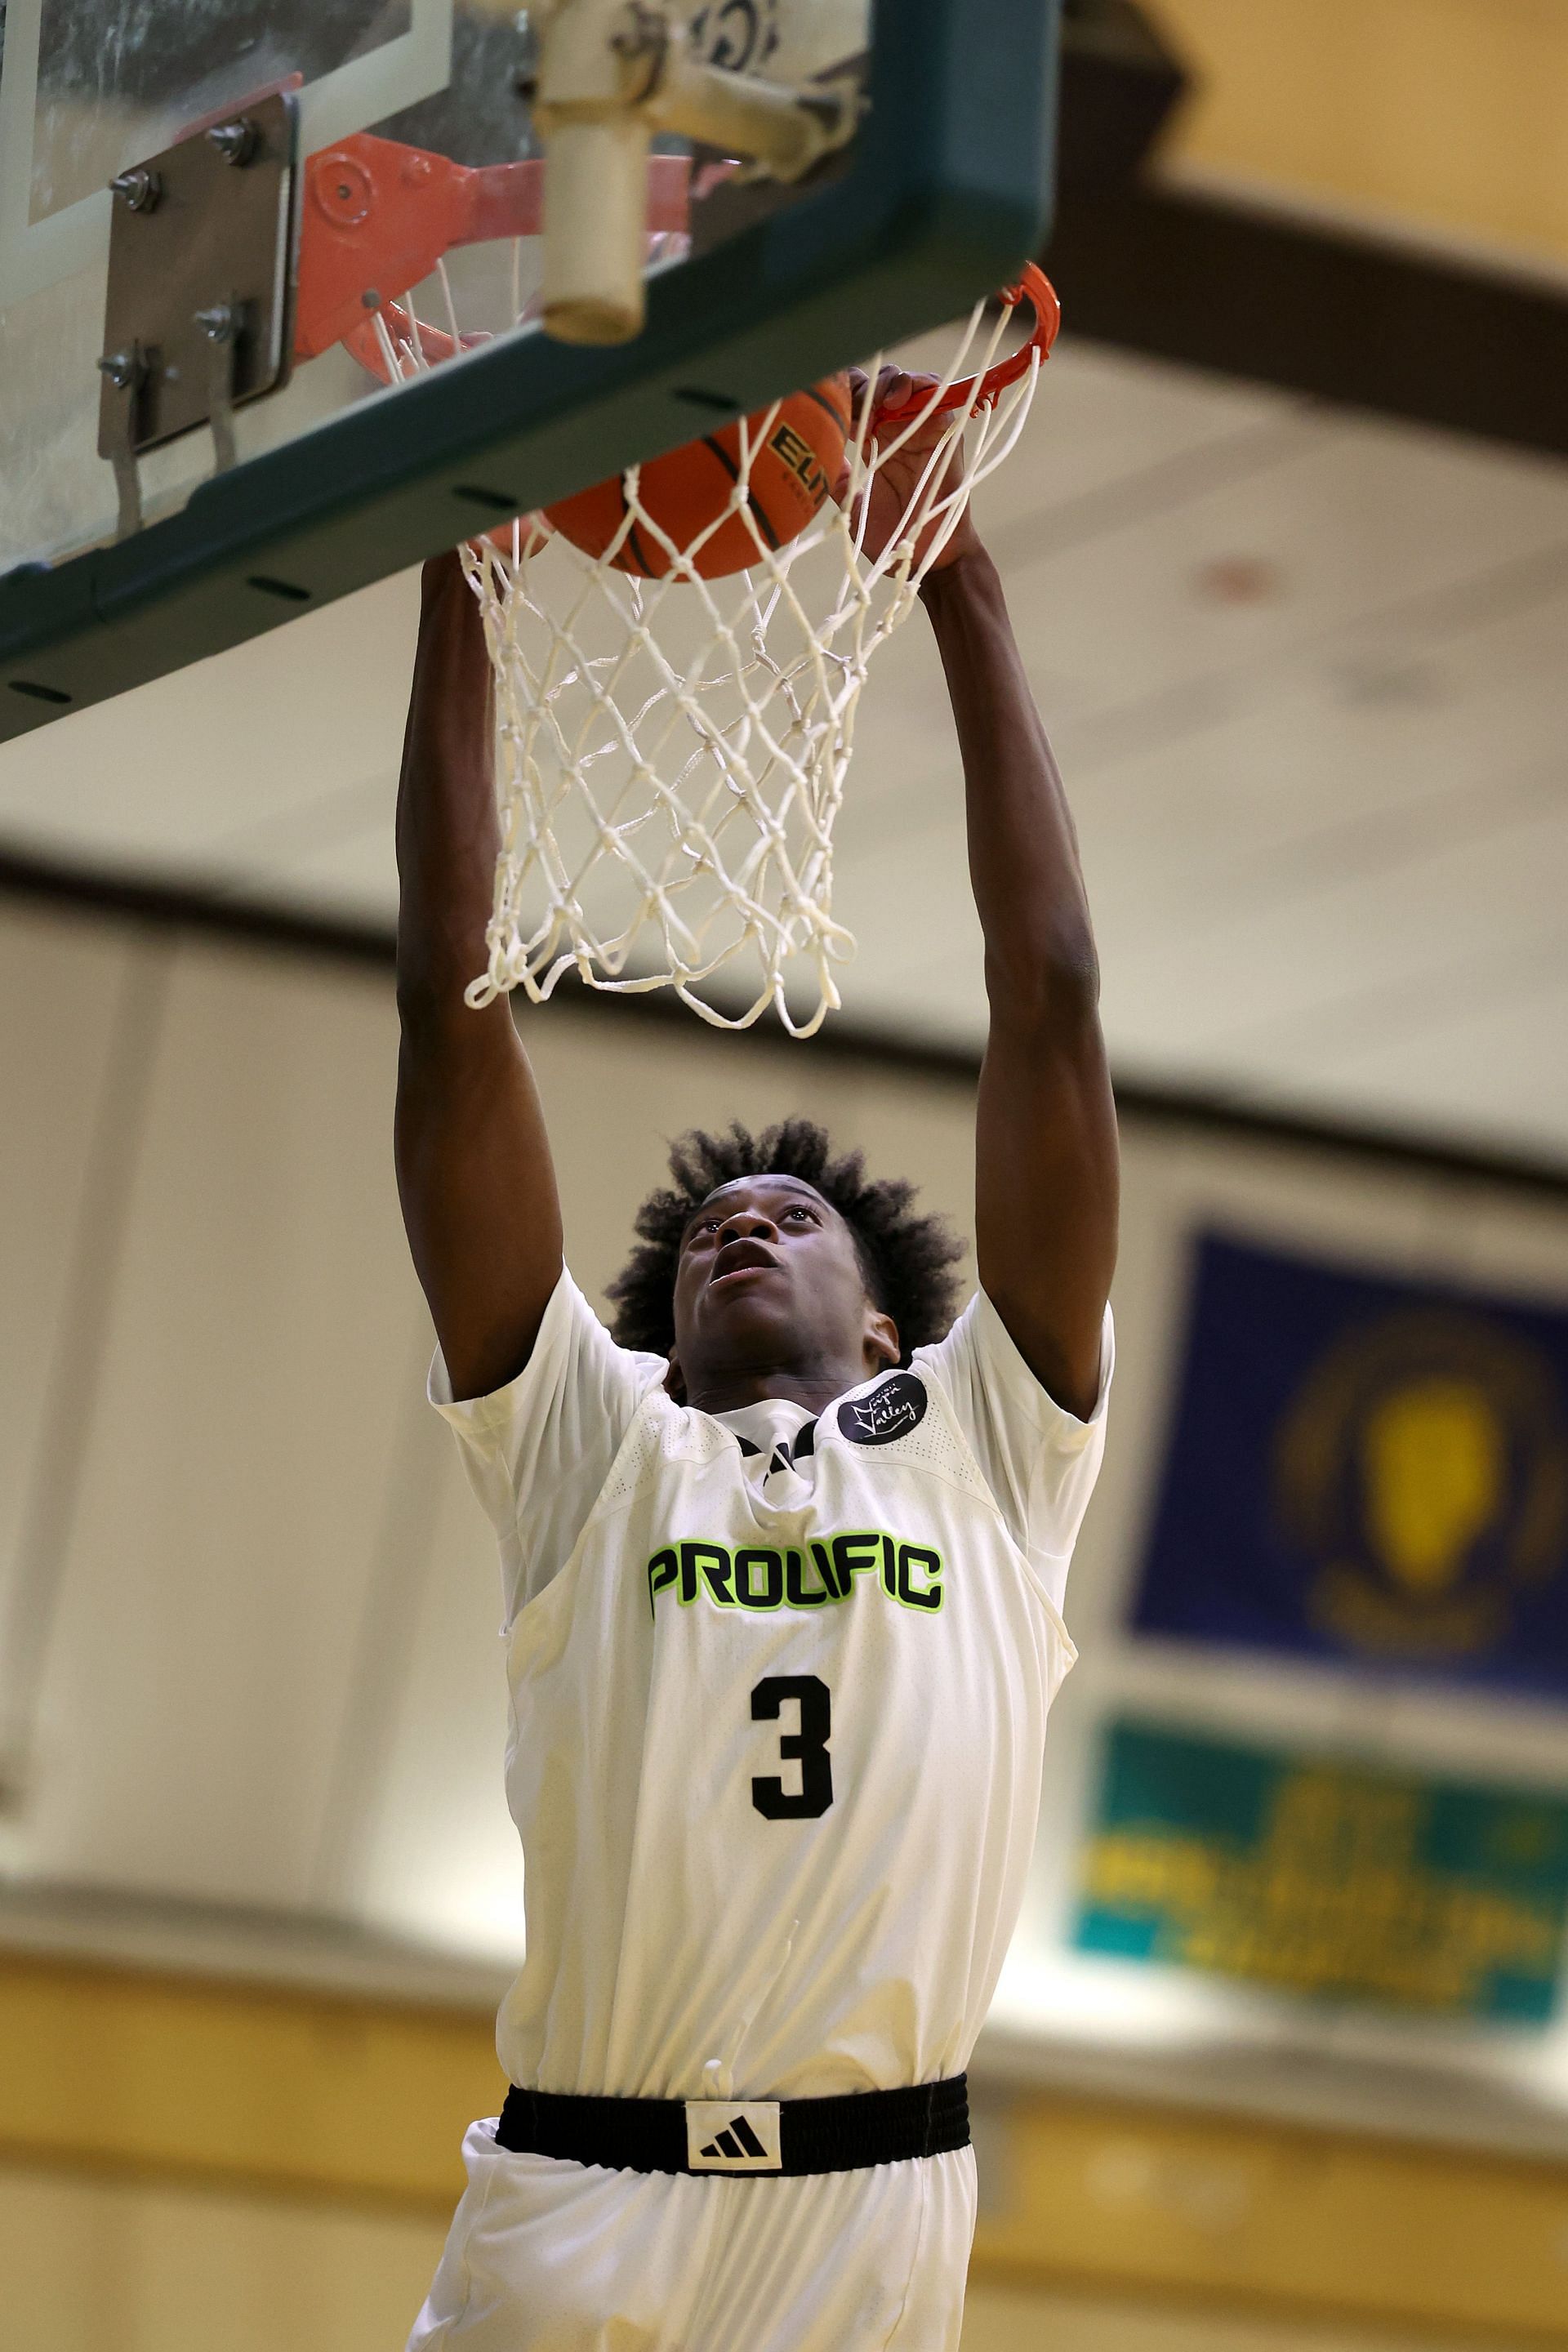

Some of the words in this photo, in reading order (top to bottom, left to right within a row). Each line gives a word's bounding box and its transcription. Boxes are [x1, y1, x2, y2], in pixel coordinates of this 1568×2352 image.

[853, 1401, 919, 1435] Valley
[648, 1530, 944, 1620] PROLIFIC
[751, 1675, 834, 1820] 3
